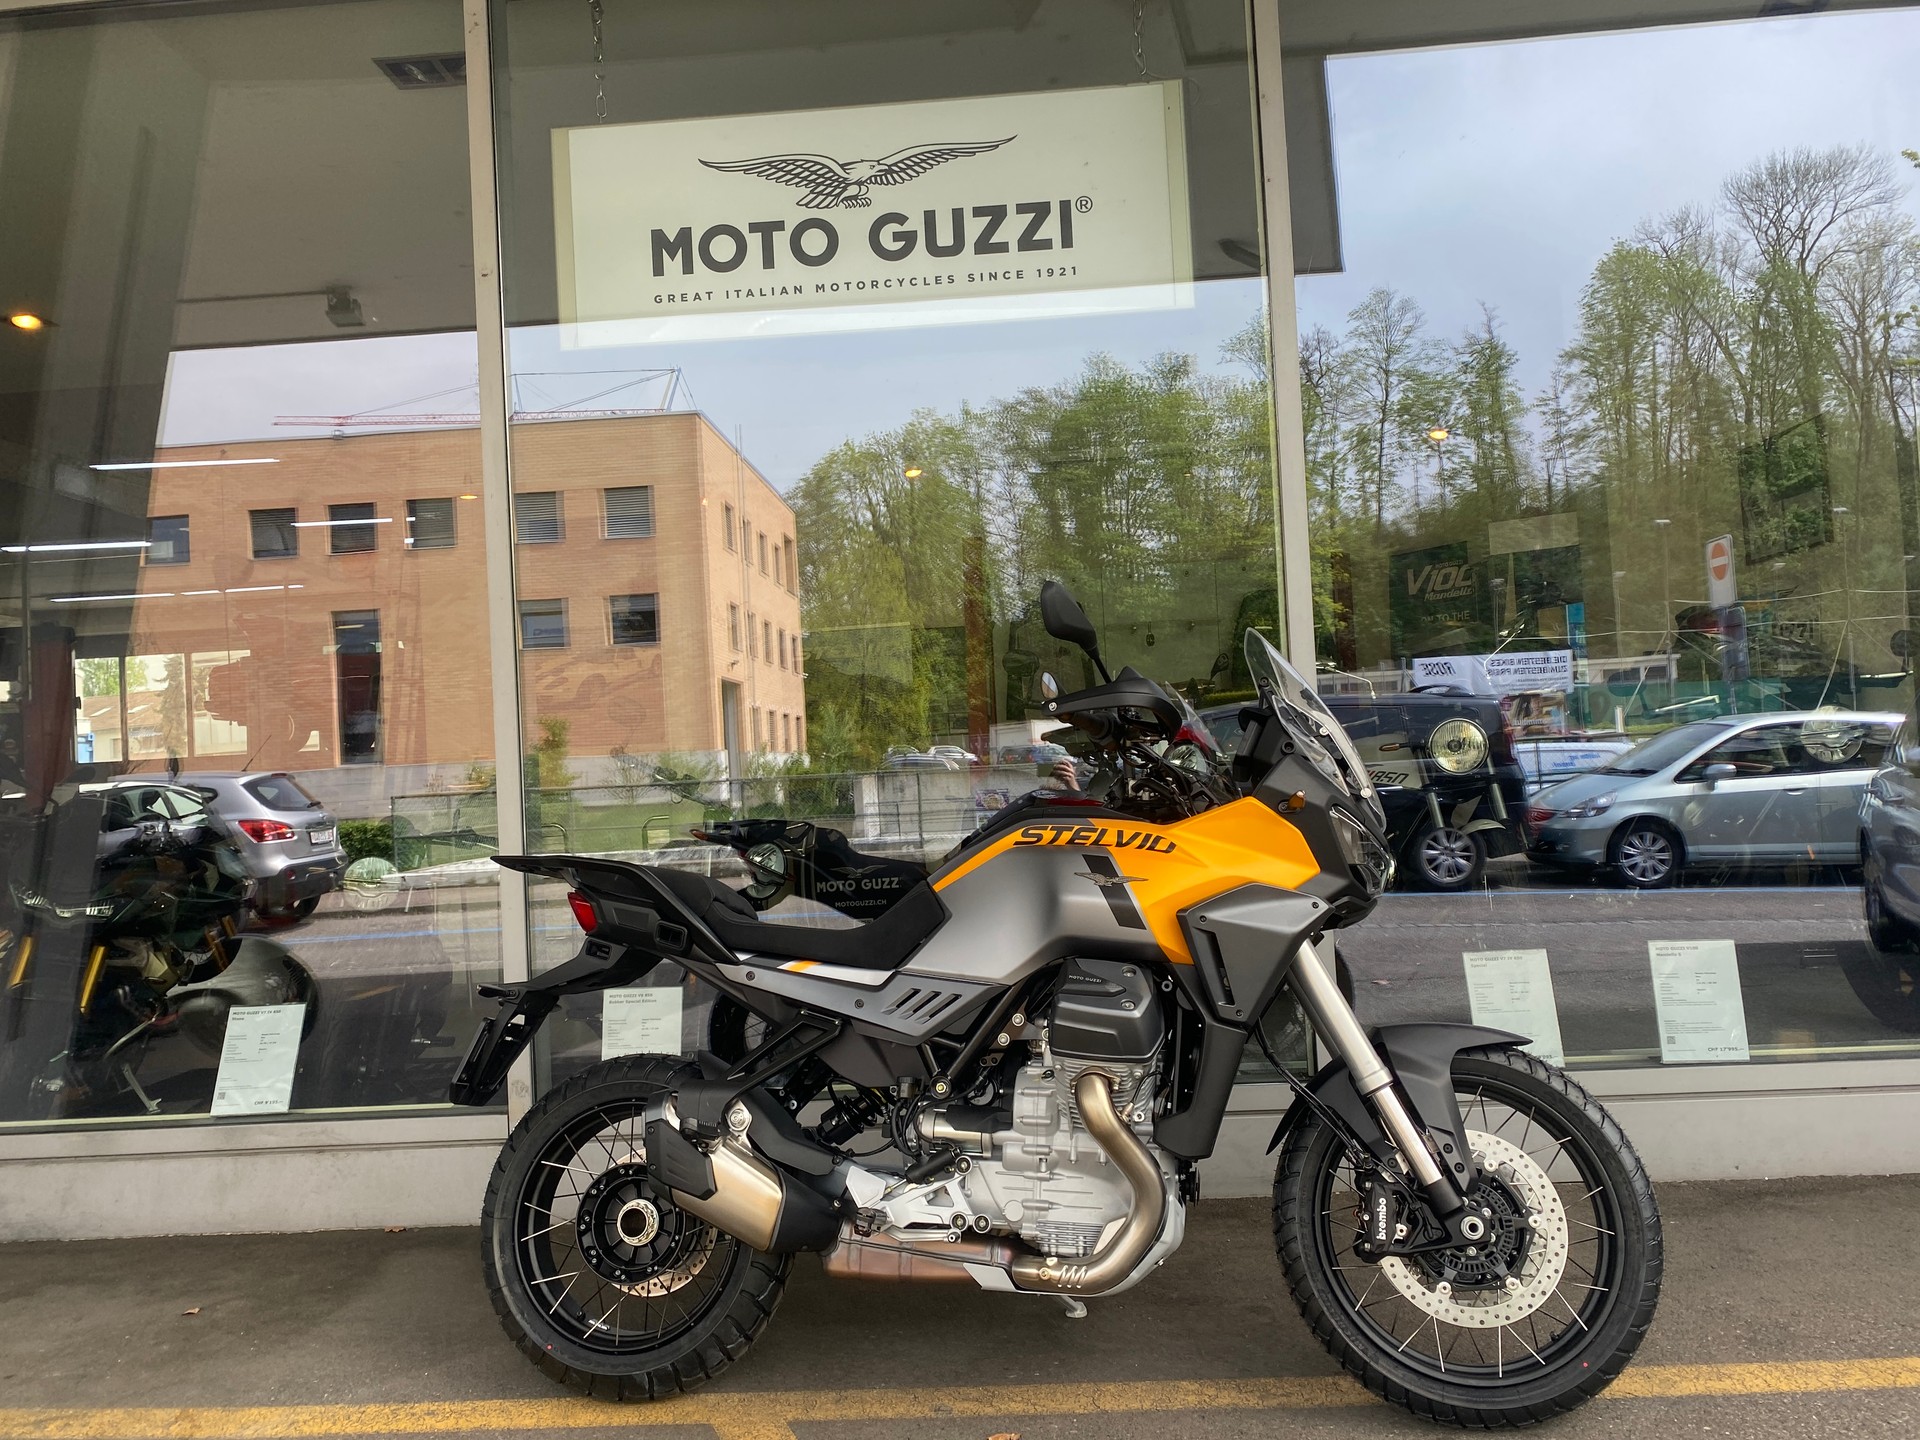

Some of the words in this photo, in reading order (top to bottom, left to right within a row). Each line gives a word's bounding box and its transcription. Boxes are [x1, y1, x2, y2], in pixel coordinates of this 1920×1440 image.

[650, 217, 839, 277] MOTO
[653, 291, 714, 304] GREAT
[725, 285, 803, 299] ITALIAN
[815, 274, 955, 293] MOTORCYCLES
[967, 269, 1024, 283] SINCE
[1036, 266, 1077, 278] 1921
[1452, 610, 1471, 620] THE
[1013, 825, 1177, 854] STELVIO
[816, 880, 856, 893] MOTO
[835, 899, 887, 908] MOTOGUZZI.CH
[1376, 1197, 1387, 1241] brembo
